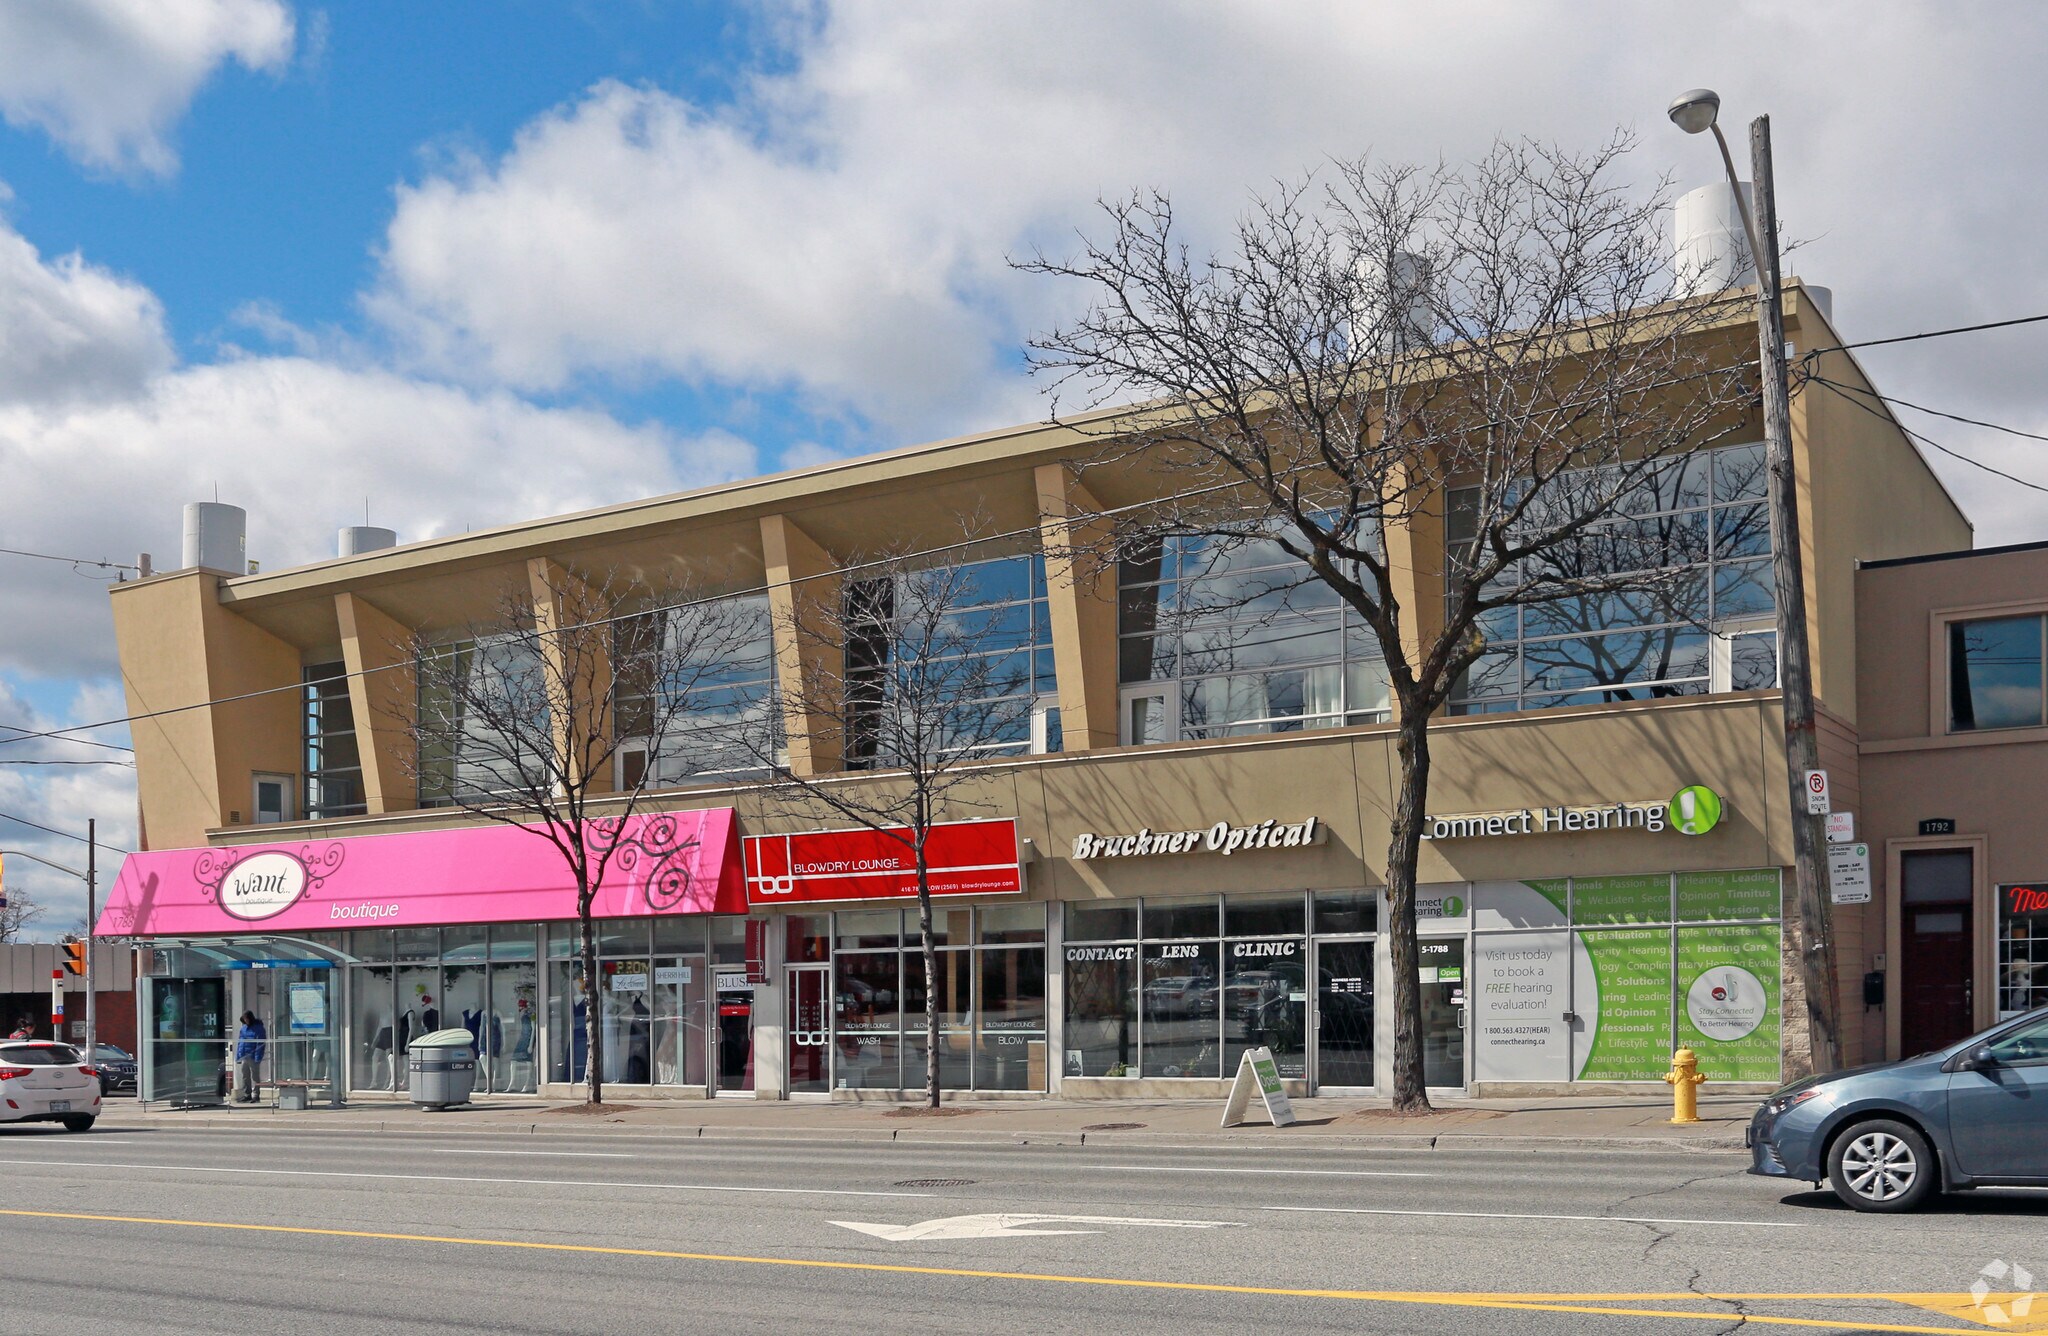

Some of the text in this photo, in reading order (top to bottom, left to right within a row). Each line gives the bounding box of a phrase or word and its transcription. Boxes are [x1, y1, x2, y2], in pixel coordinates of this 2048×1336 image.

[1542, 803, 1665, 833] Hearing
[1827, 824, 1852, 833] STANDING
[1925, 822, 1949, 832] 1792
[1073, 816, 1318, 860] Bruckner Optical
[794, 858, 899, 873] BLOWDRY LOUNGE
[961, 881, 1014, 889] blowdrylounge.com
[1610, 879, 1645, 889] Passion
[1685, 875, 1724, 886] Hearing
[1732, 873, 1776, 884] Leading
[1589, 896, 1604, 905] We
[1606, 894, 1634, 904] Listen
[1680, 891, 1720, 902] Opinion
[1727, 888, 1771, 899] Tinnitus
[1416, 897, 1442, 907] nnect
[330, 902, 399, 921] boutique
[1719, 905, 1760, 915] Passion
[112, 915, 134, 929] 1788
[1597, 931, 1651, 940] Evaluation
[1707, 928, 1723, 937] We
[1726, 926, 1758, 936] Listen
[1066, 942, 1295, 962] CONTACT LENS CLINIC
[1421, 945, 1449, 954] 5-1788
[1628, 945, 1666, 956] Hearing
[1697, 943, 1740, 954] Hearing
[1743, 942, 1767, 951] Care
[1485, 949, 1552, 961] Visit us today
[656, 971, 677, 979] SHERRI
[1440, 969, 1459, 977] Open
[1493, 966, 1544, 977] to book a
[1616, 976, 1665, 986] Solutions
[1485, 983, 1552, 995] FREE hearing
[1491, 999, 1547, 1010] evaluation!
[1615, 1008, 1656, 1018] Opinion
[1699, 1007, 1754, 1016] Stay Connected
[1728, 1020, 1754, 1028] Hearing
[857, 1037, 880, 1045] WASH
[998, 1036, 1024, 1045] BLOW
[1490, 1038, 1546, 1046] connecthearing.ca
[1609, 1038, 1648, 1050] Lifestyle
[1656, 1038, 1671, 1048] We
[1624, 1054, 1645, 1063] Loss
